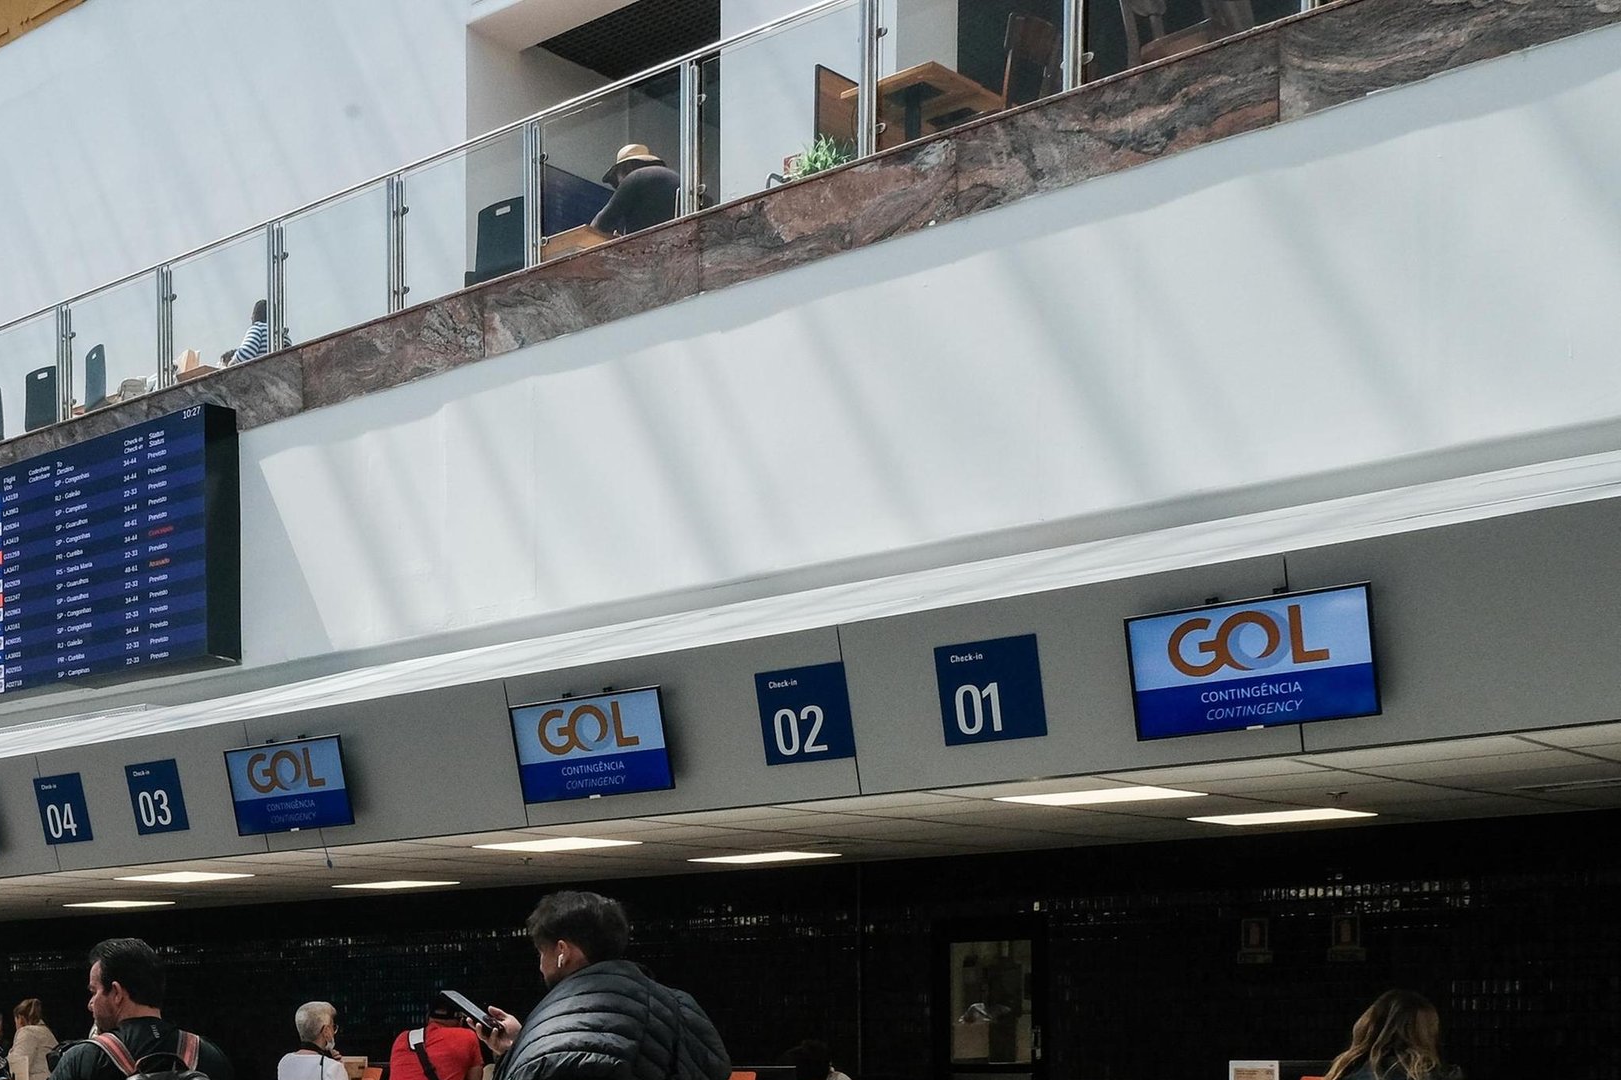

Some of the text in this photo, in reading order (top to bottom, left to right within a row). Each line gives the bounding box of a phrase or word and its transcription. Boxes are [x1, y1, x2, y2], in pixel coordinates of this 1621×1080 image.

[182, 407, 200, 419] 10:27
[147, 449, 166, 460] Previsto
[147, 465, 166, 475] Previsto
[147, 480, 167, 491] Previsto
[148, 496, 167, 506] Previsto
[148, 511, 167, 521] Previsto
[148, 542, 167, 552] Previsto
[148, 573, 168, 583] Previsto
[148, 588, 168, 598] Previsto
[149, 604, 168, 613] Previsto
[149, 619, 168, 628] Previsto
[149, 635, 168, 644] Previsto
[1167, 604, 1330, 678] GOL
[149, 650, 168, 659] Previsto
[950, 653, 983, 664] Check-in
[768, 678, 798, 690] Check-in
[1200, 681, 1303, 704] CONTINGÊNCIA
[955, 682, 1003, 736] 01
[1206, 699, 1304, 722] CONTINGENCY
[538, 701, 639, 756] GOL
[773, 705, 828, 756] 02
[247, 747, 326, 794] GOL
[561, 761, 625, 776] CONTINGÊNCIA
[566, 774, 626, 790] CONTINGENCY
[138, 789, 172, 827] 03
[46, 803, 78, 838] 04
